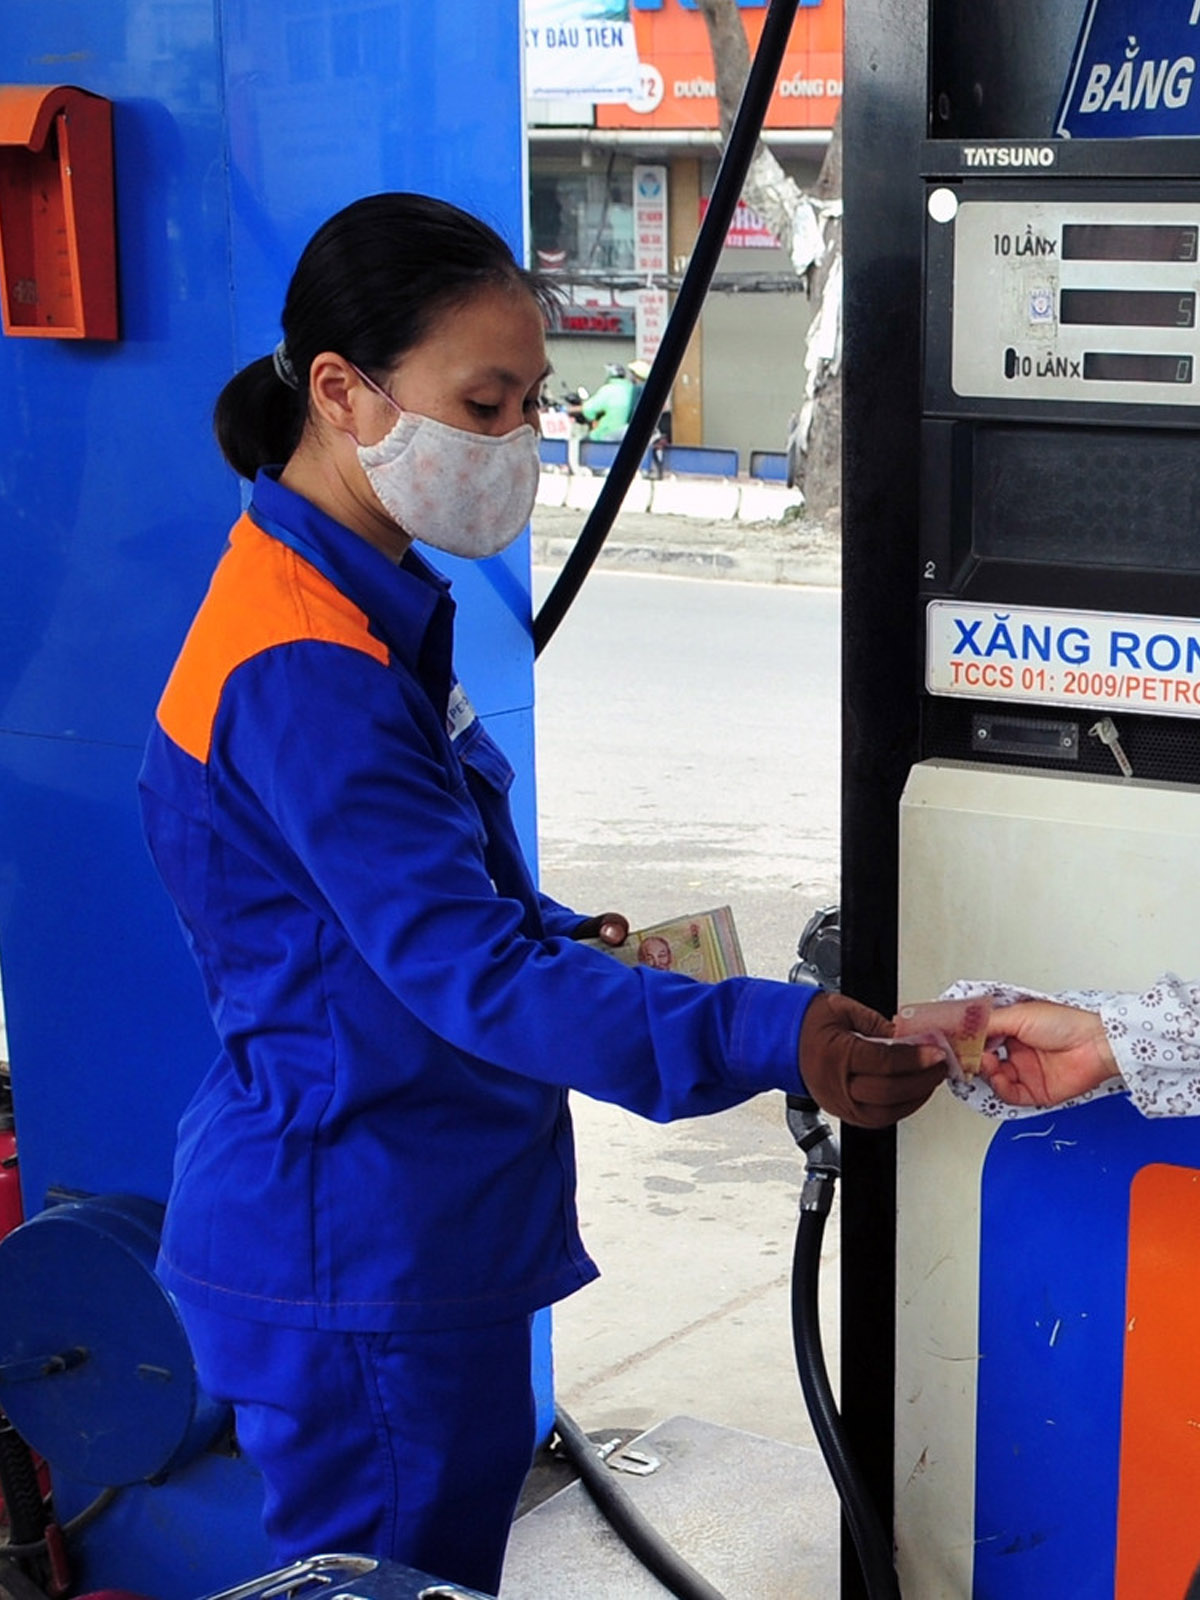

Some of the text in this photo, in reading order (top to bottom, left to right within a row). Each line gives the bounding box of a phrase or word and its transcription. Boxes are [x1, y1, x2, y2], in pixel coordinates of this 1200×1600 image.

[1079, 36, 1196, 113] BẰNG
[964, 148, 1055, 167] TATSUNO
[924, 561, 936, 579] 2
[953, 612, 1091, 665] XĂNG
[950, 661, 1013, 688] TCCS
[1022, 667, 1055, 692] 01:
